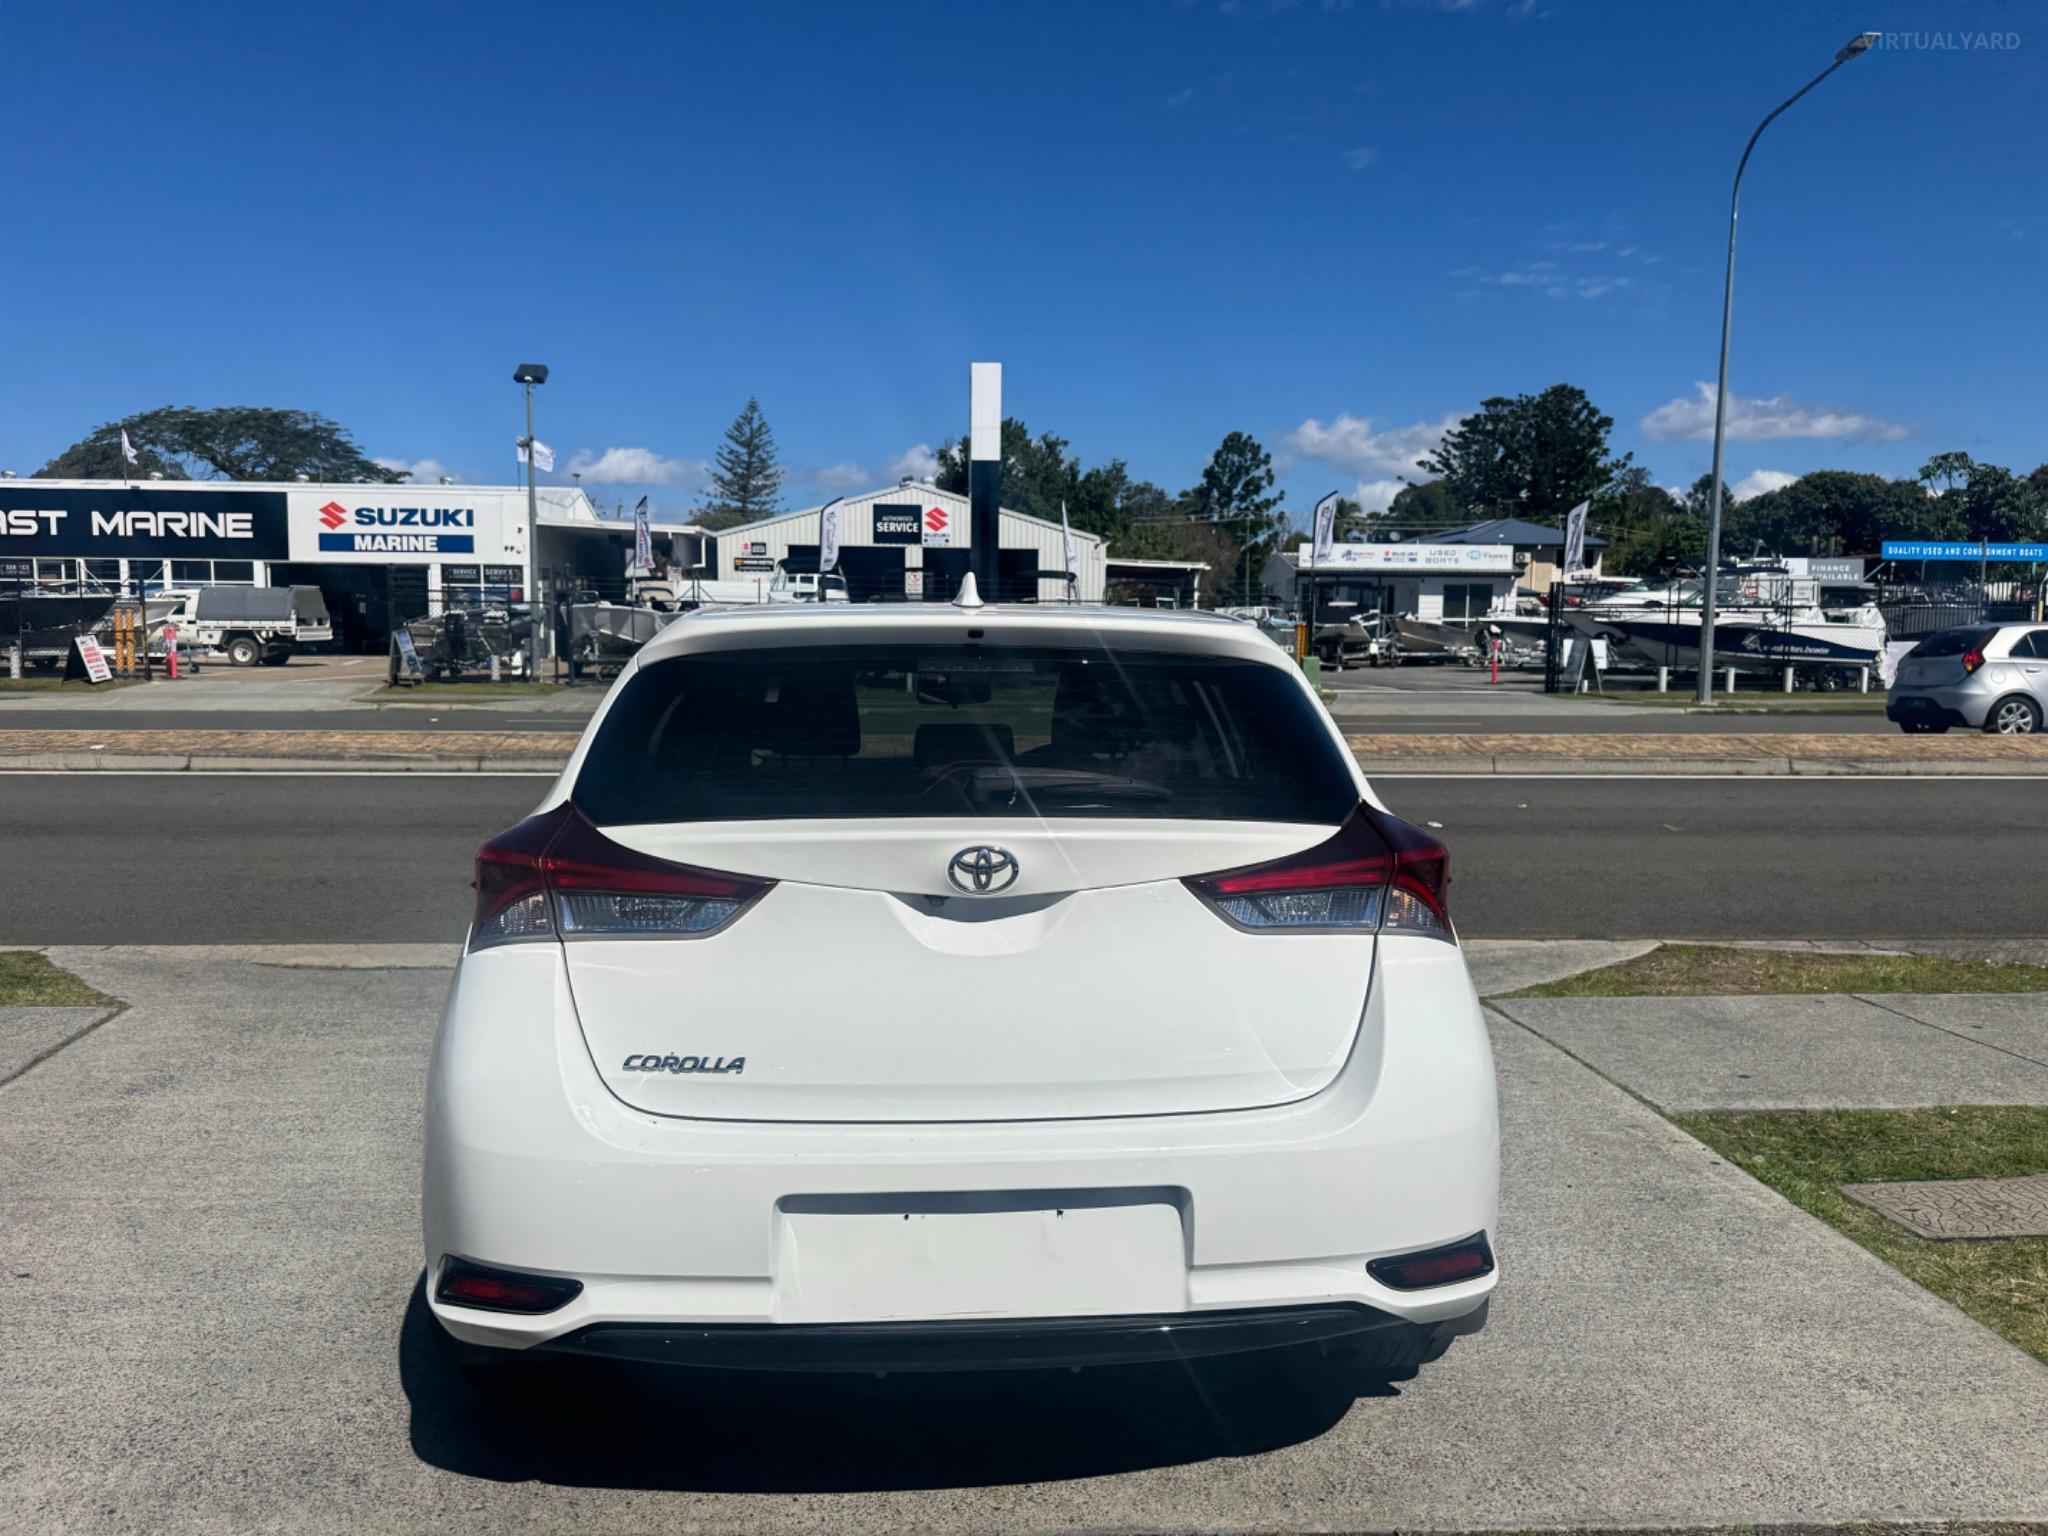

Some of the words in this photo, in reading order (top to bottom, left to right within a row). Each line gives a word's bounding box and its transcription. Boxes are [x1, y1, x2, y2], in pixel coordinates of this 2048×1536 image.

[91, 511, 254, 539] MARINE
[355, 508, 474, 527] SUZUKI
[876, 522, 919, 533] SERVICE
[354, 535, 438, 551] MARINE
[1888, 546, 1920, 555] QUALITY
[1923, 547, 1942, 555] USED
[1945, 547, 1960, 555] AND
[1963, 547, 2016, 556] CONSGNMENT
[2019, 548, 2043, 557] BOATS
[1811, 564, 1850, 572] FINANCE
[622, 1054, 746, 1075] COROLLA
